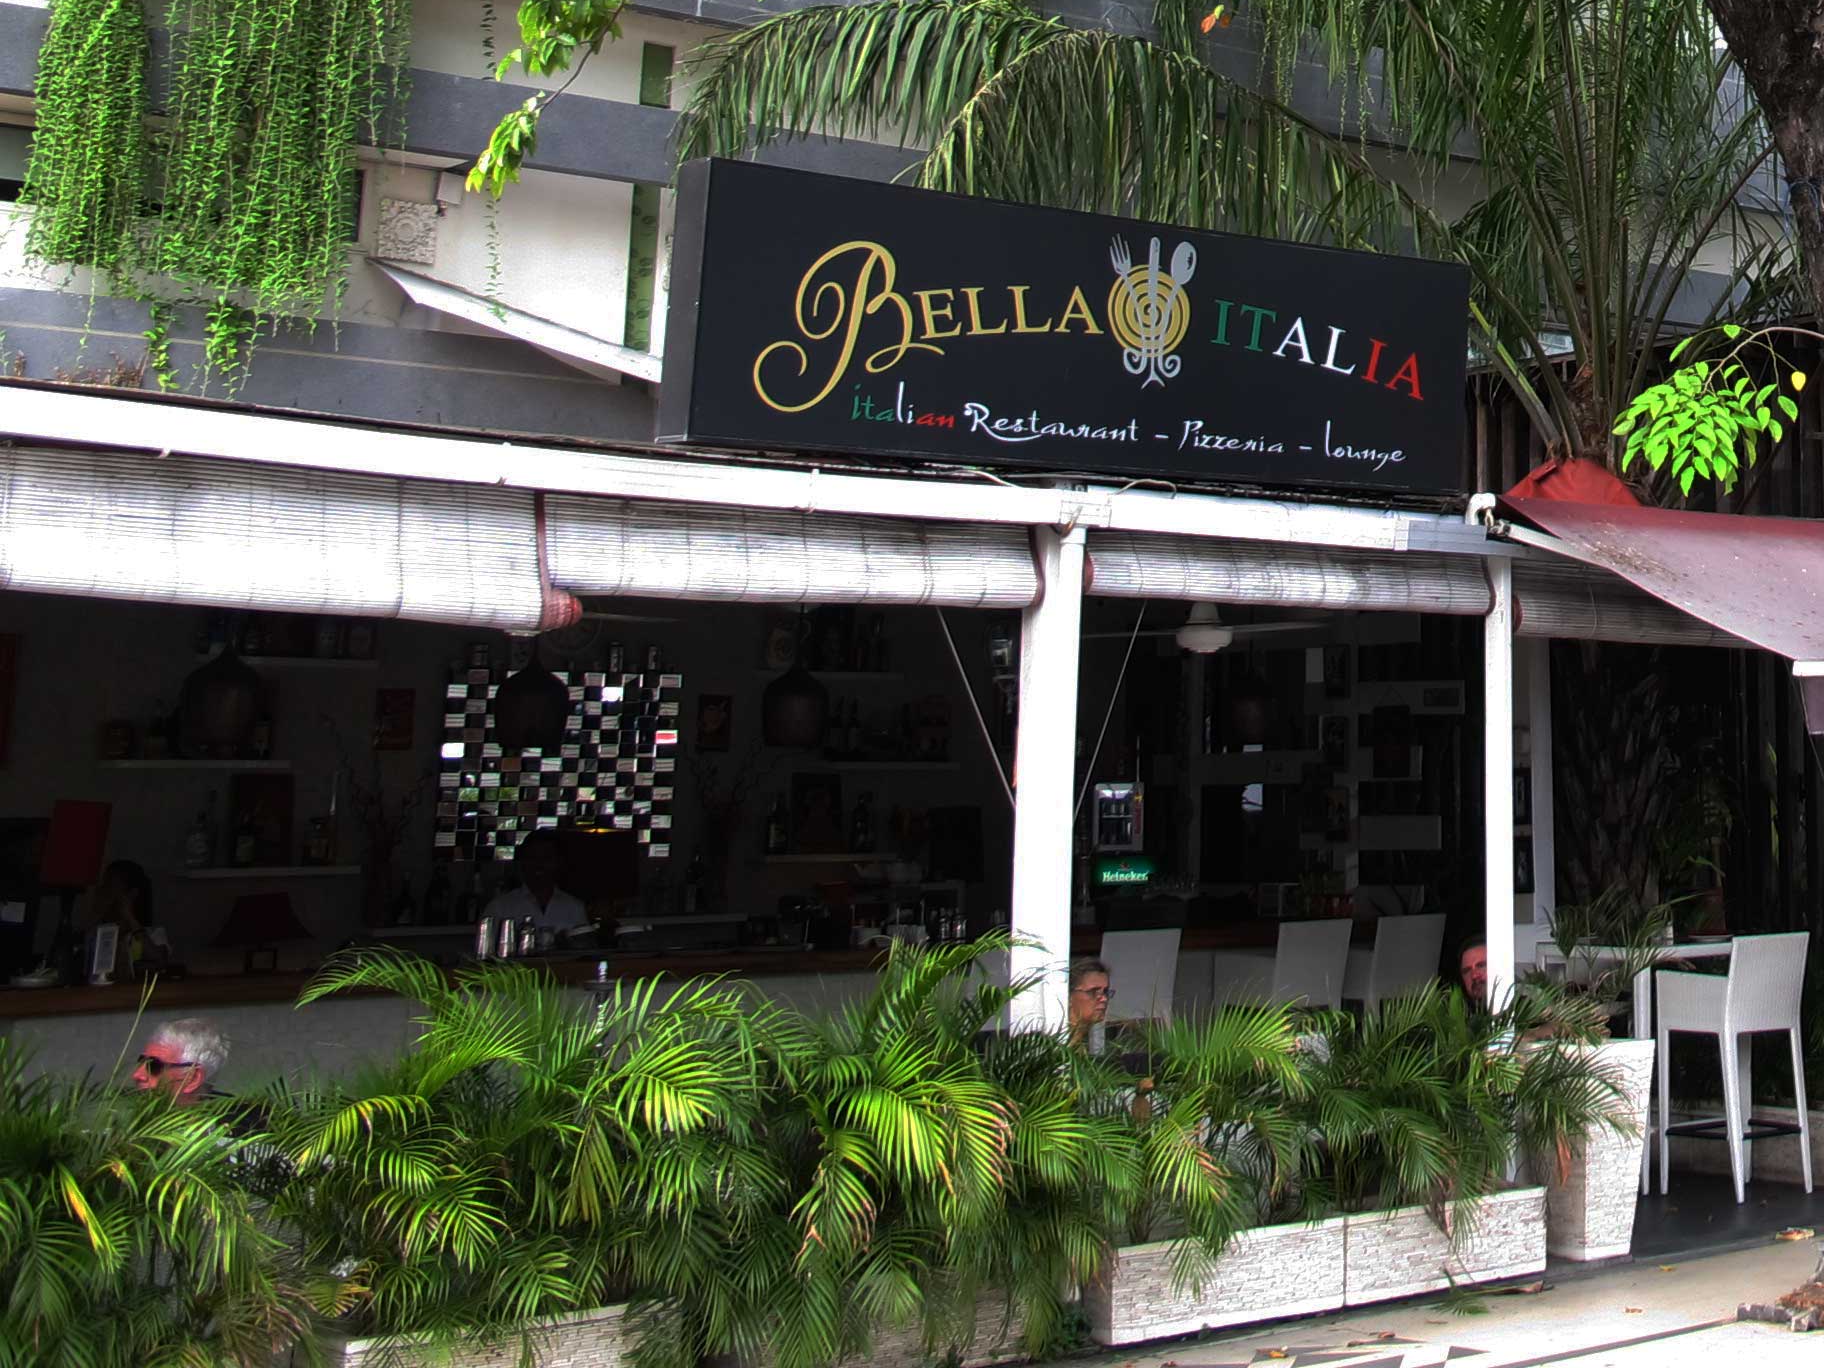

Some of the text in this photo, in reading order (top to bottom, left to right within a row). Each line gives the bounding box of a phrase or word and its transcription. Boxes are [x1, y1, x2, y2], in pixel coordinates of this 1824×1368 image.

[753, 240, 1425, 413] BELLA ITALIA
[964, 402, 1139, 443] Restaurant
[1178, 419, 1286, 455] Pizzeria
